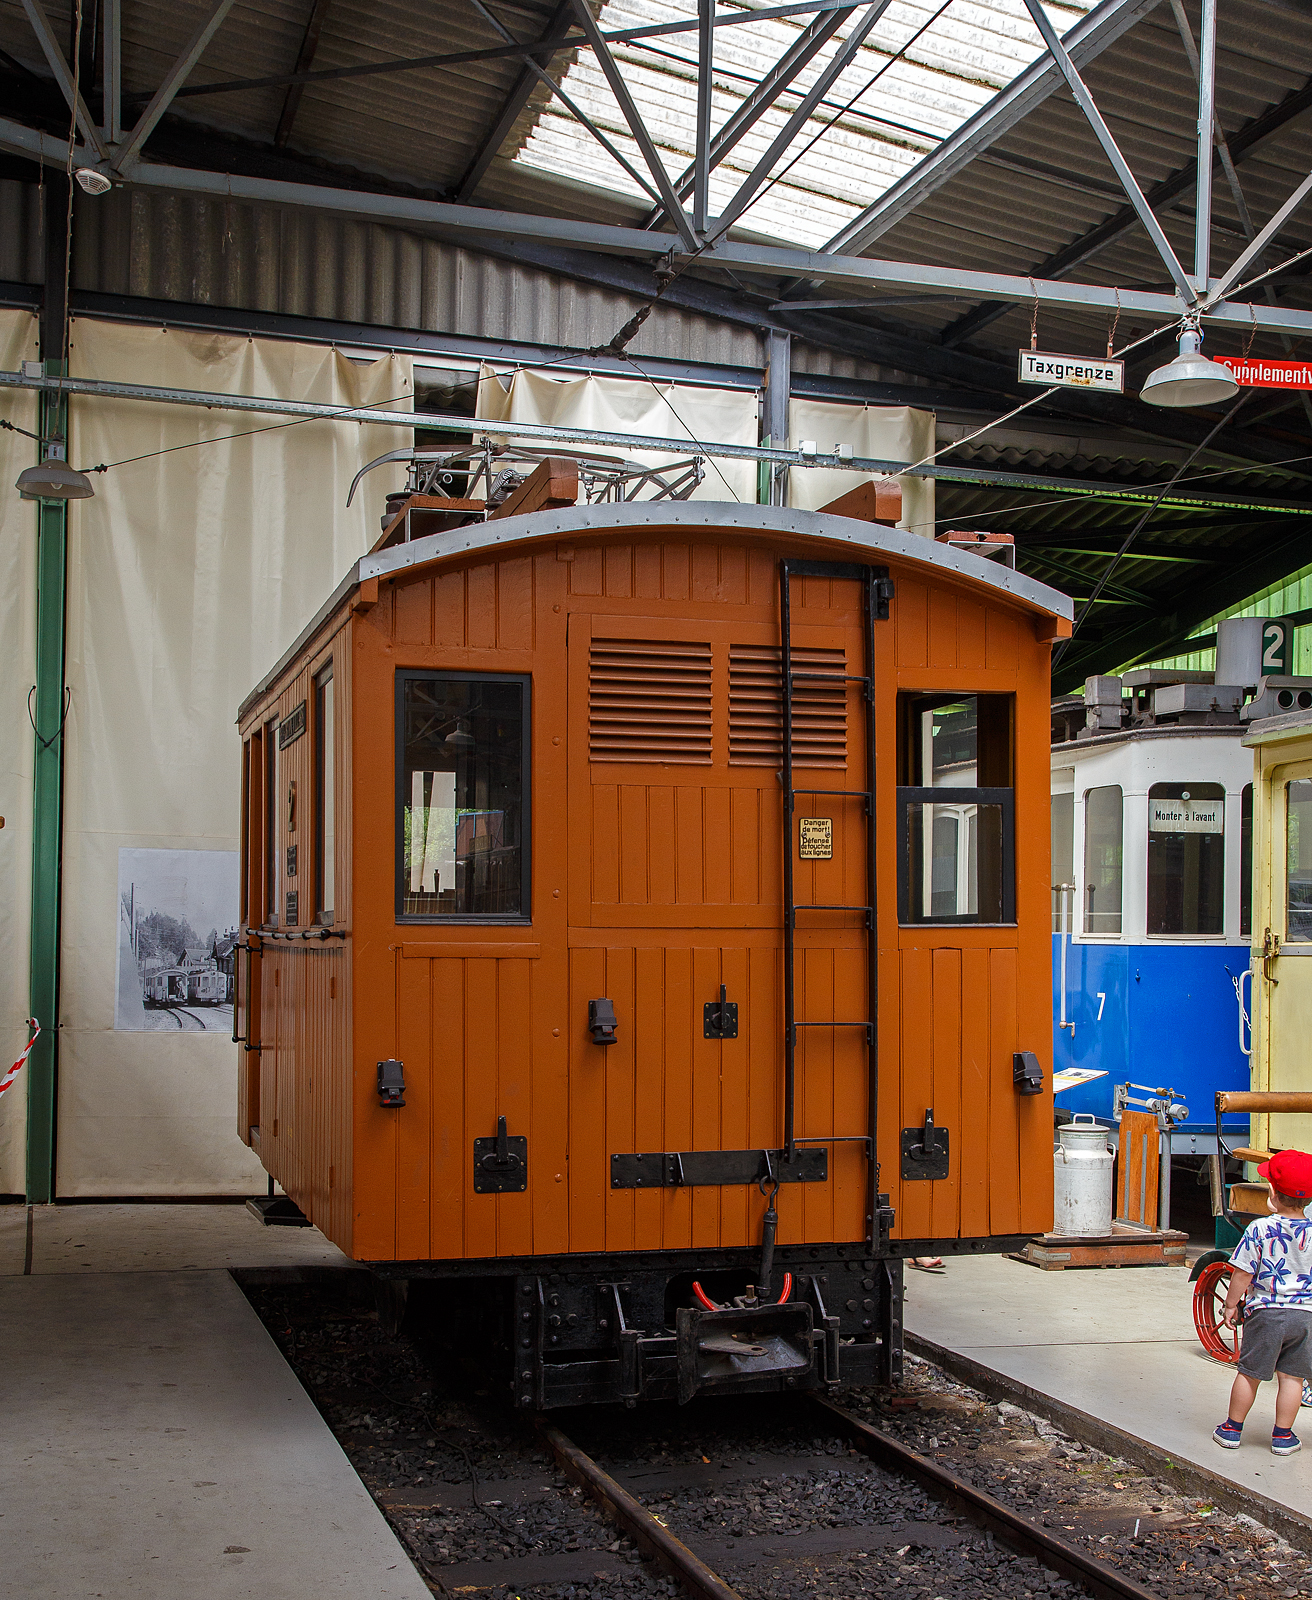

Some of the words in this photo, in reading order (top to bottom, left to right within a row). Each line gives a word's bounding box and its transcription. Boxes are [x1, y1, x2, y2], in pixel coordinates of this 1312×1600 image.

[1026, 357, 1114, 381] Taxgrenze
[1263, 625, 1284, 668] 2
[804, 819, 829, 827] Danger
[1155, 810, 1182, 821] Monter
[1184, 811, 1190, 821] à
[1192, 811, 1216, 822] l'avant
[1096, 992, 1106, 1021] 7
